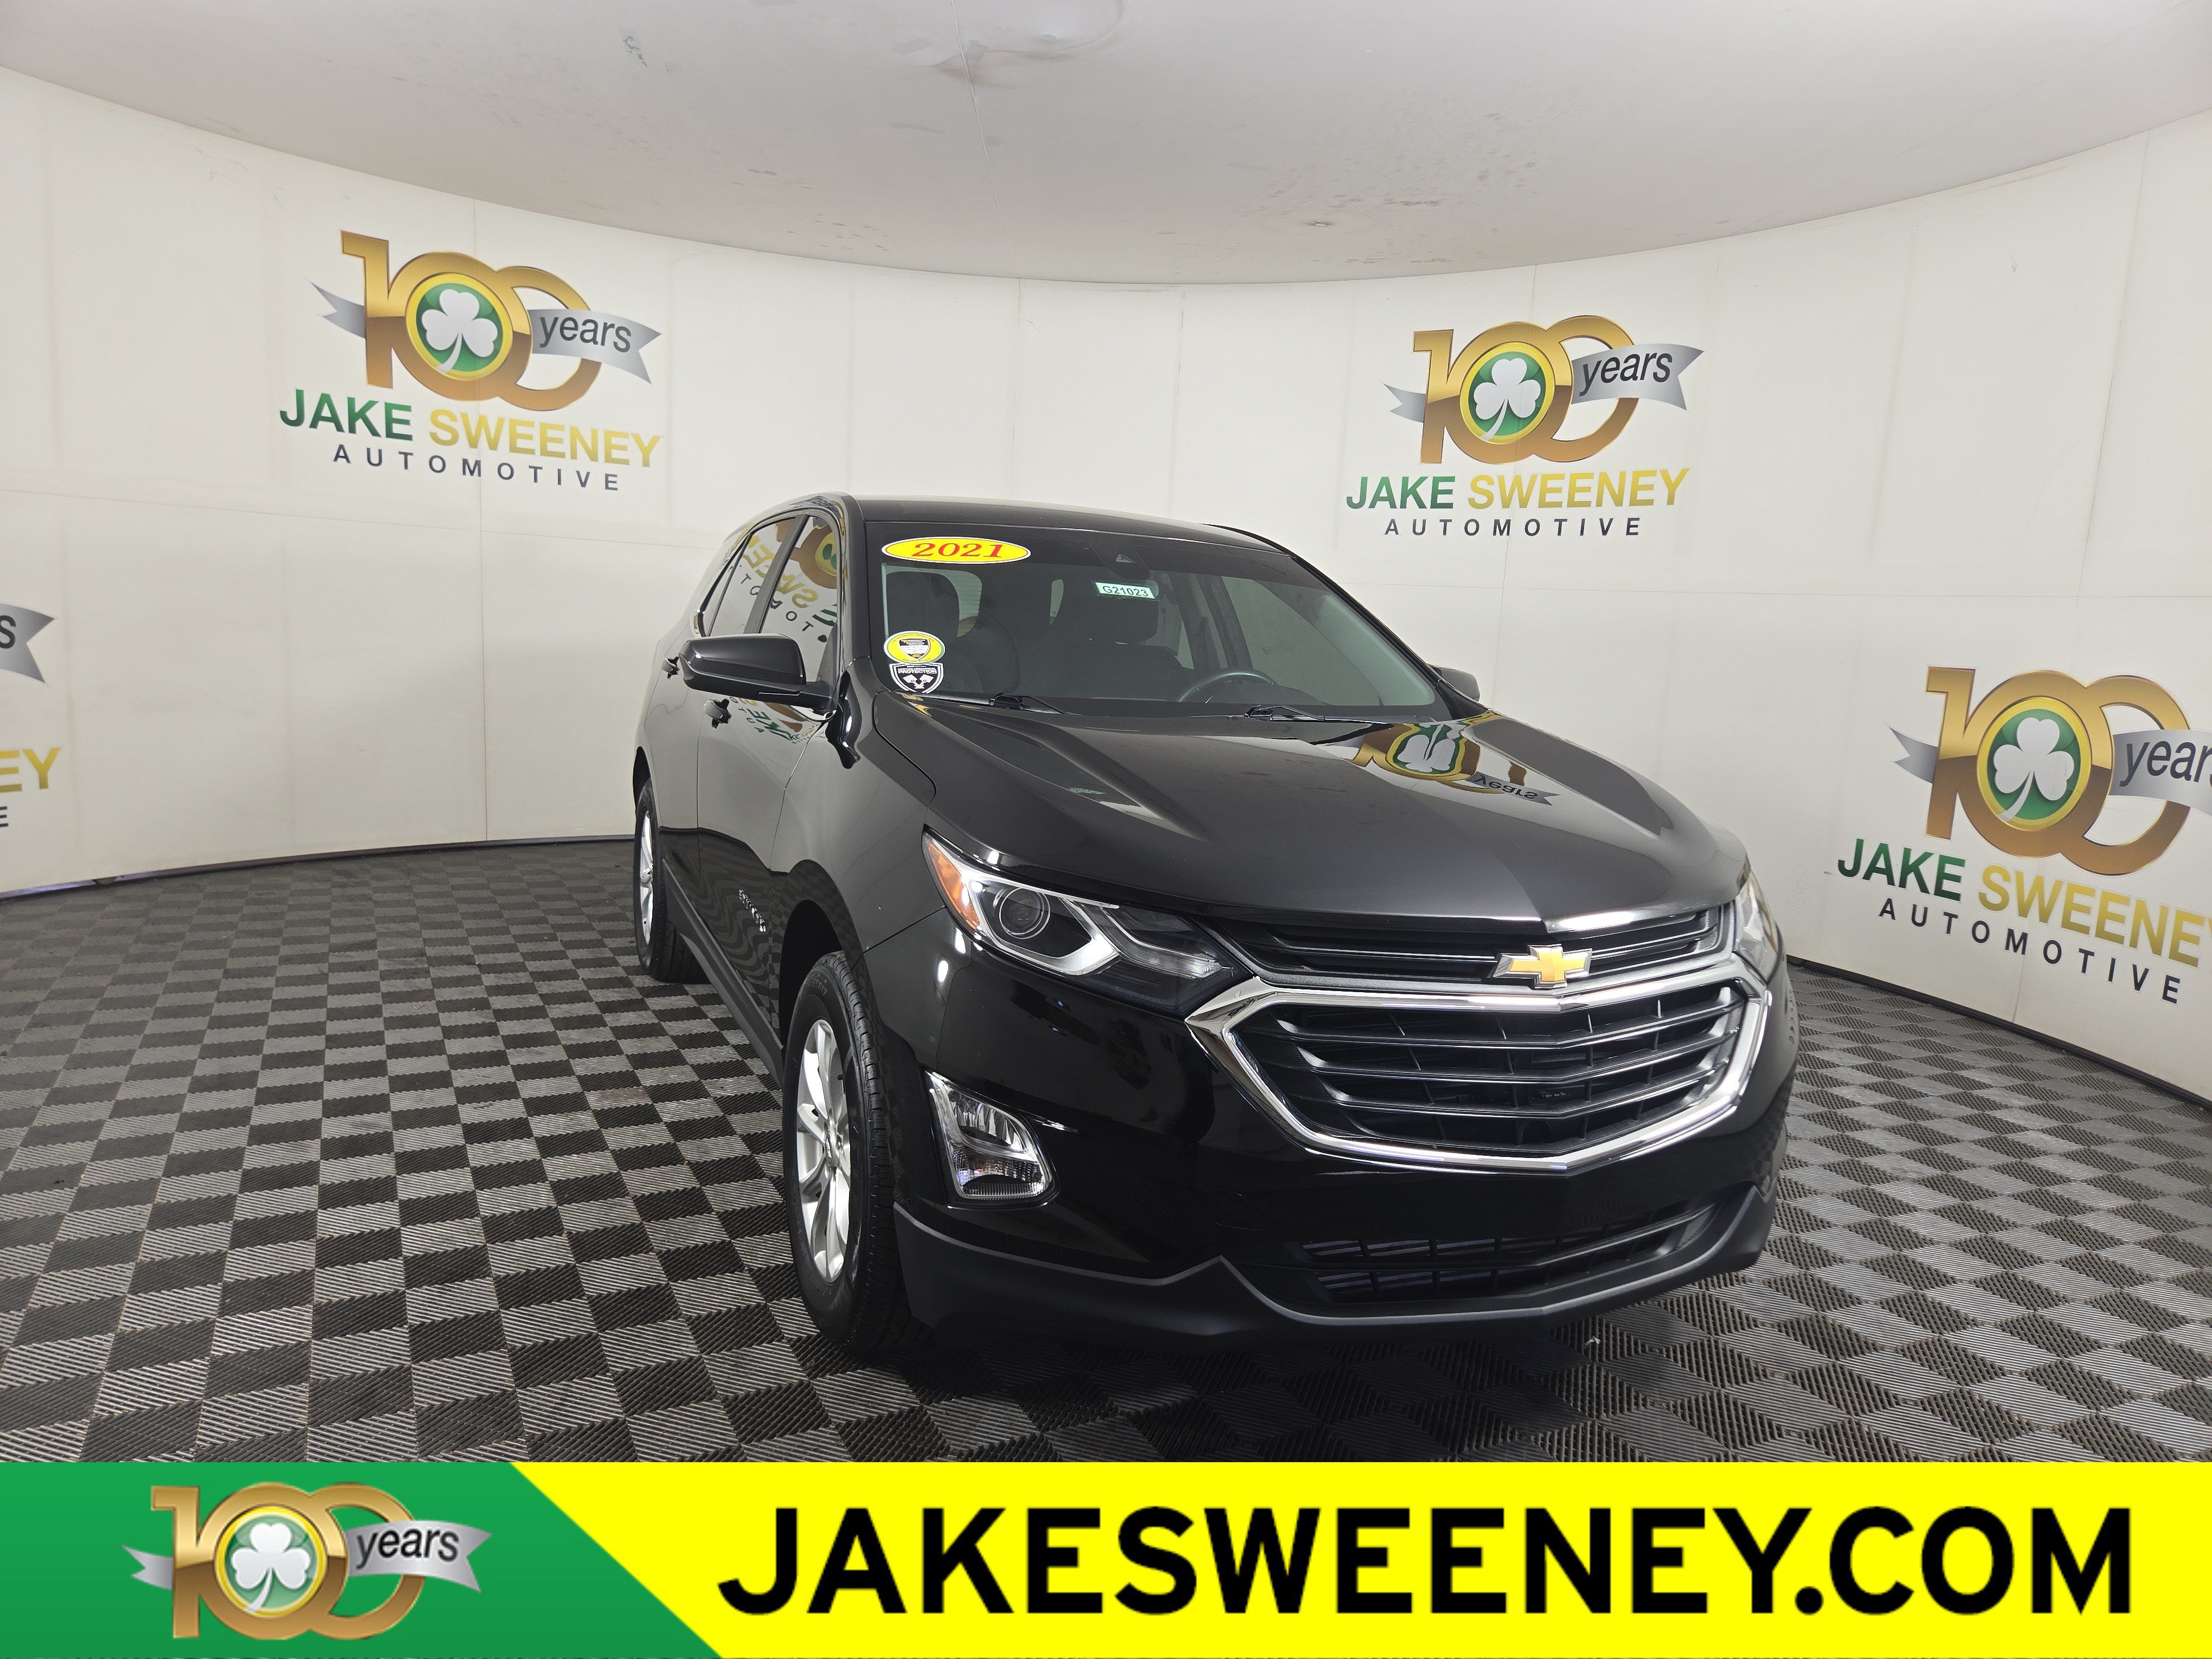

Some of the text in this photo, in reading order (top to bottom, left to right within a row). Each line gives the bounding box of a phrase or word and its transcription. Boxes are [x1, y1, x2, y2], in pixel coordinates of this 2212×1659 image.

[539, 316, 633, 353] years
[1579, 351, 1673, 396] years
[279, 389, 661, 467] JAKE SWEENEY
[333, 444, 618, 491] AUTOMOTIVE
[1346, 468, 1690, 510] JAKE SWEENEY
[1384, 517, 1640, 537] AUTOMOTIVE
[911, 543, 1004, 557] 2021
[1103, 586, 1148, 597] G21023
[2119, 741, 2212, 787] year
[1837, 838, 2212, 968] JAKE SWEENE
[1879, 898, 2181, 1004] AUTOMOTIVE
